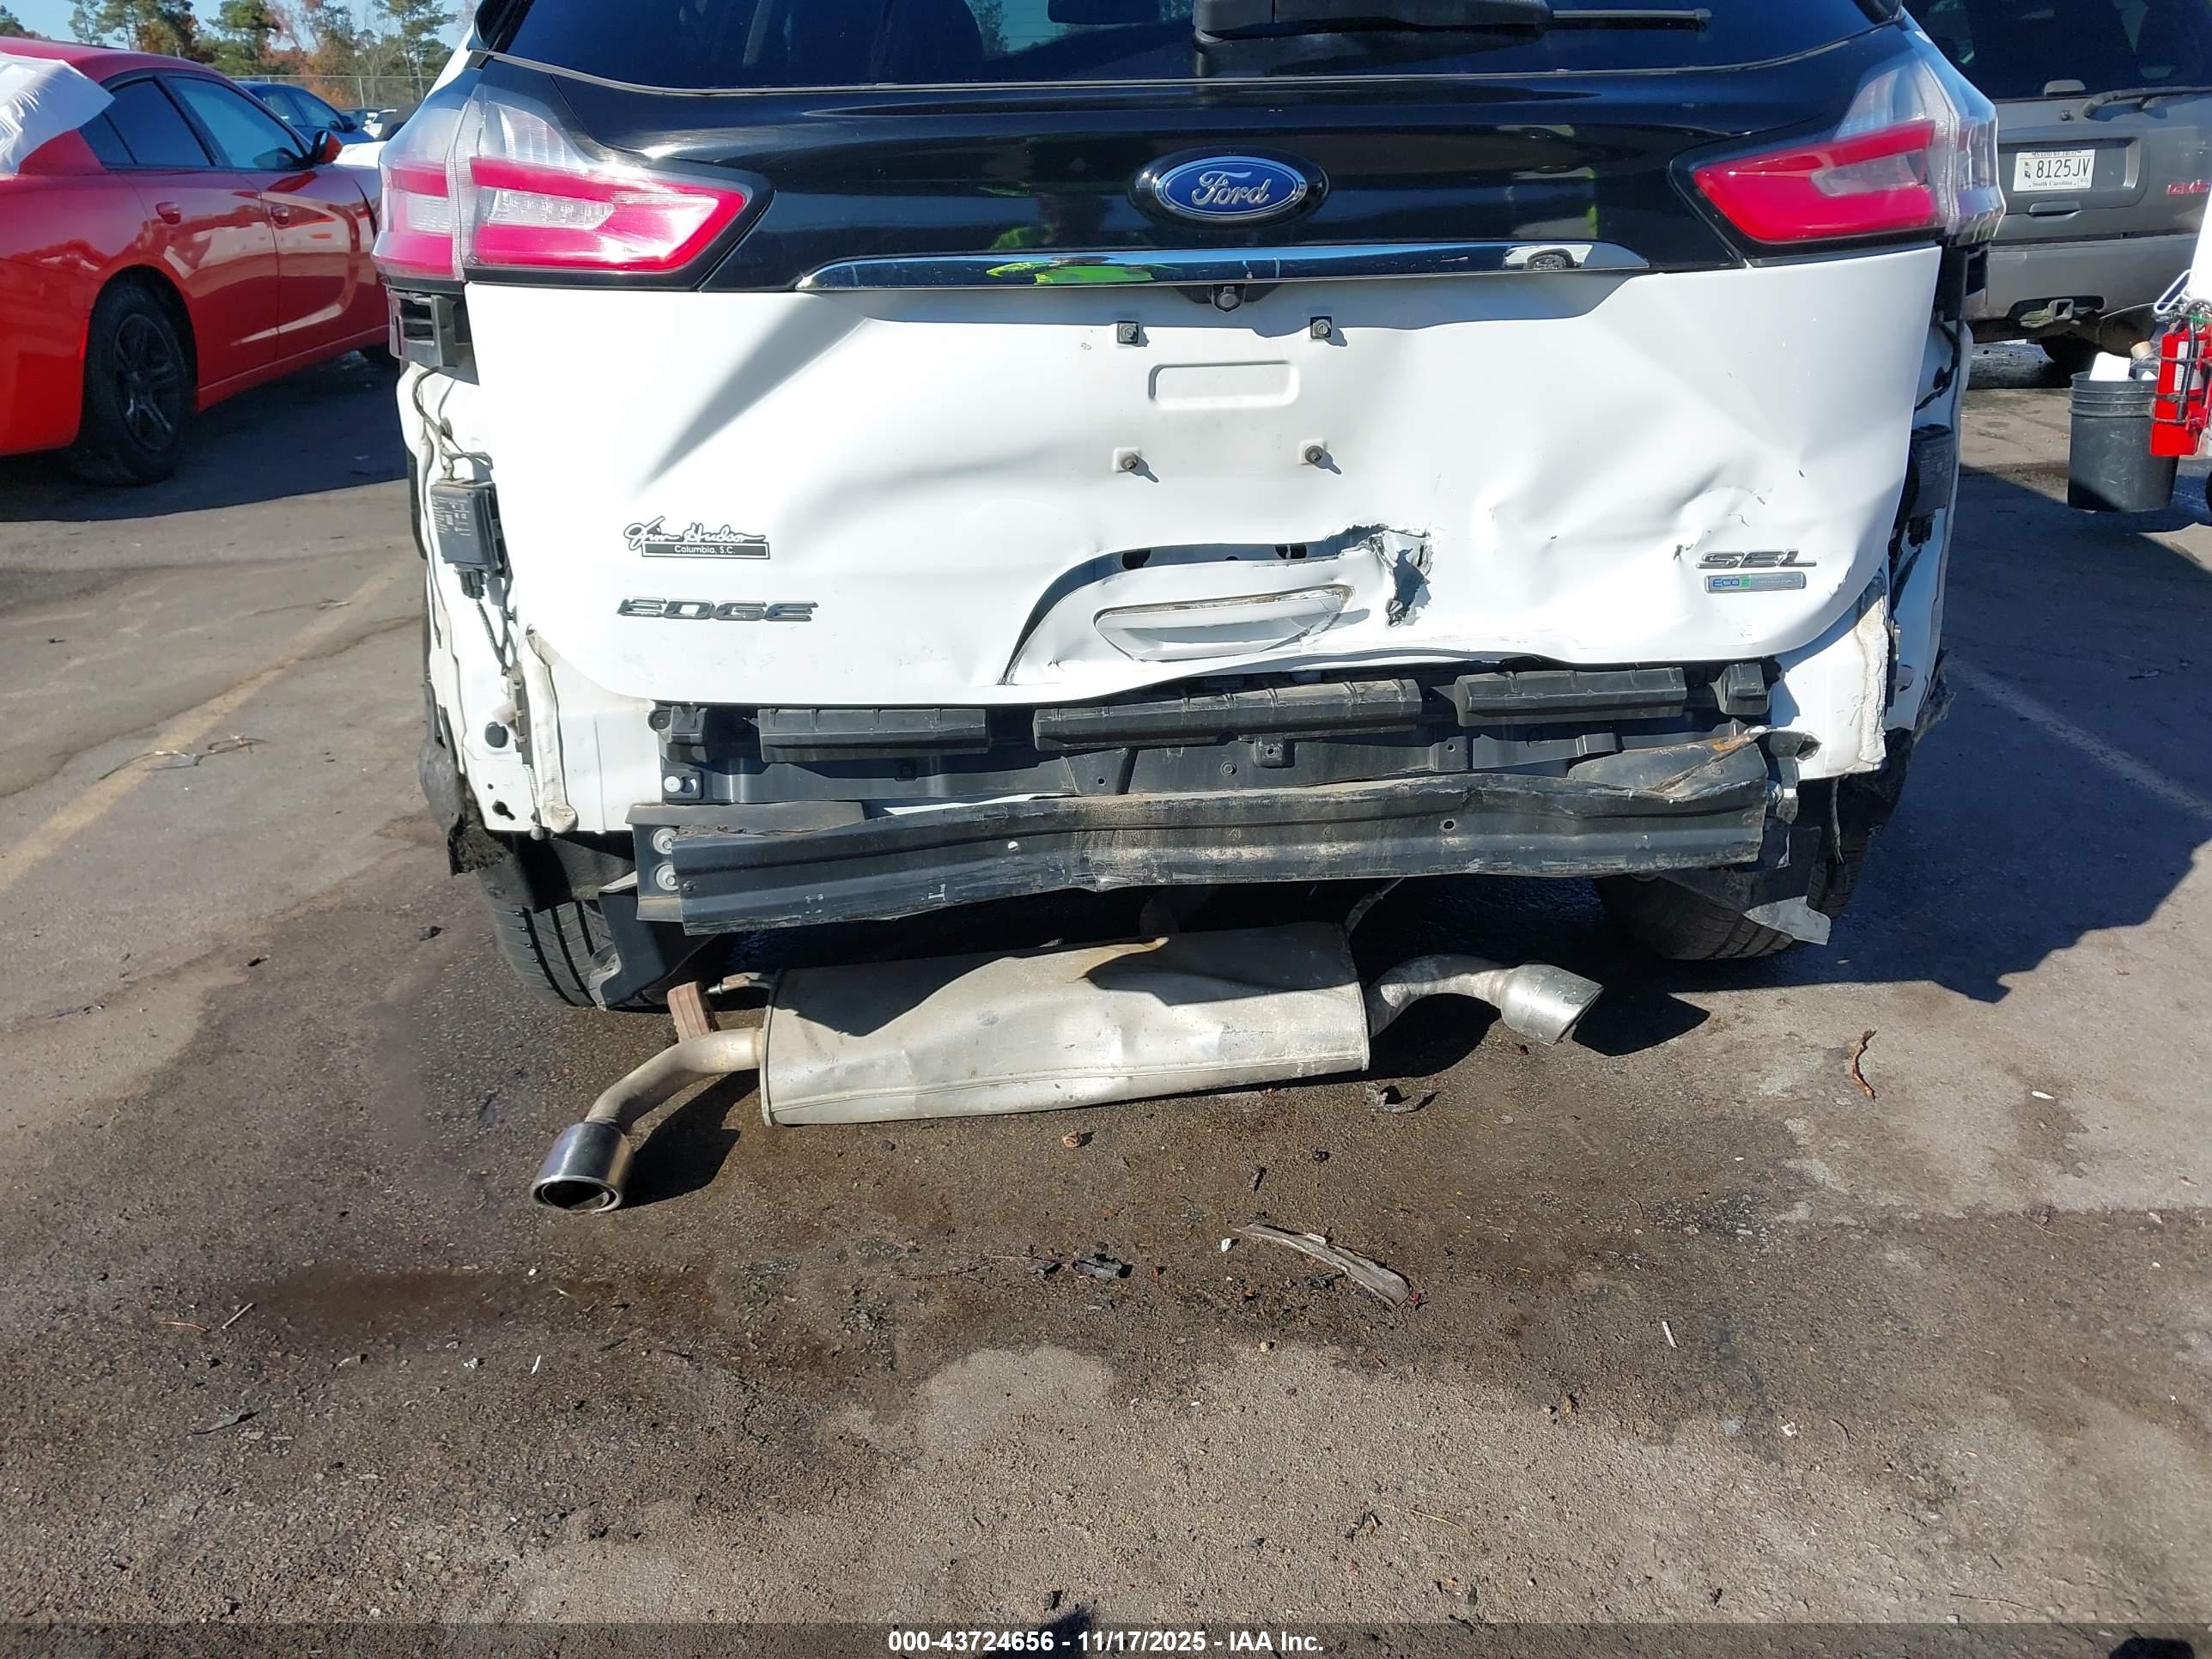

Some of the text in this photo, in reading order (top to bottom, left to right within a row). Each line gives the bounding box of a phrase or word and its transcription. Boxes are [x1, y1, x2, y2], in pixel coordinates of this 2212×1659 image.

[2036, 158, 2090, 179] 8125JV
[1191, 171, 1272, 206] Ford
[674, 544, 736, 555] Columbia, S.C.
[1696, 550, 1817, 568] SEL
[617, 598, 818, 622] EDGE
